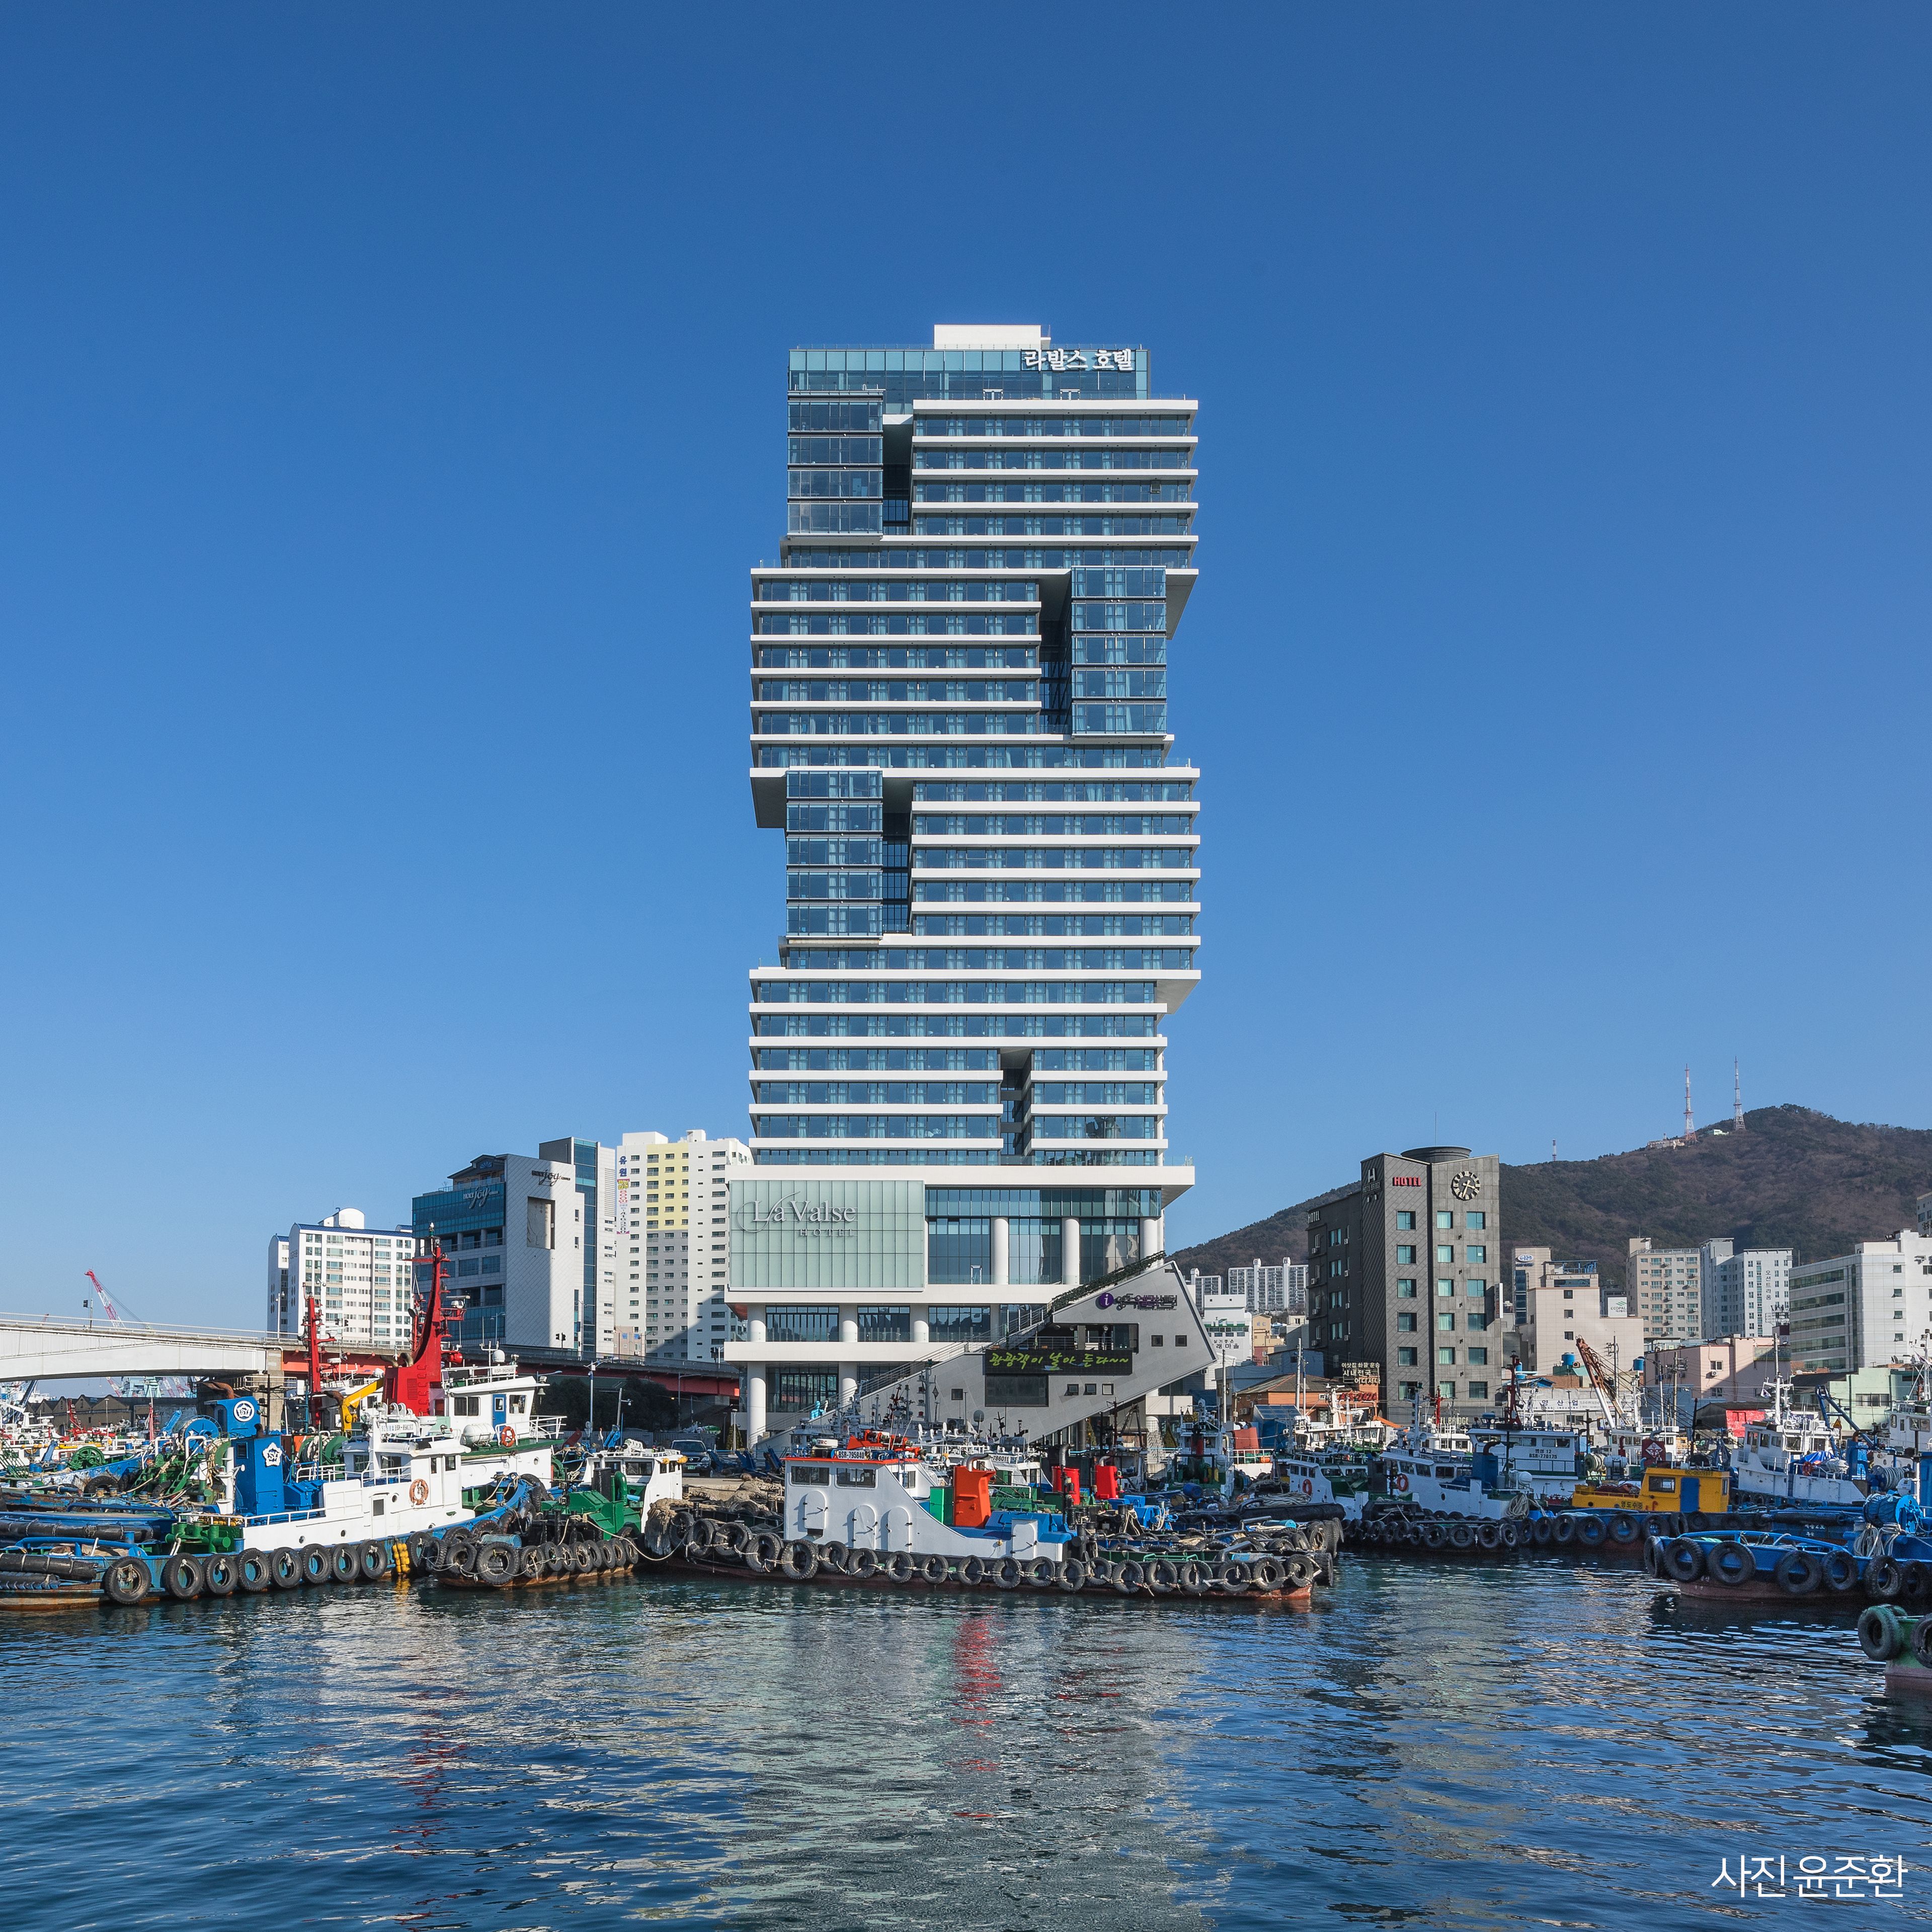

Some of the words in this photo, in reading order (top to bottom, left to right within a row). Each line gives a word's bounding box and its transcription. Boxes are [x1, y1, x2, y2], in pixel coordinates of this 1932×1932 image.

[1024, 348, 1088, 371] 라발스
[1092, 348, 1133, 371] 호텔
[1394, 1176, 1422, 1186] HOTEL
[1308, 1211, 1320, 1223] HOTEL
[799, 1228, 855, 1237] HOTEL
[989, 1352, 1042, 1370] 관광객이
[838, 1451, 864, 1459] BSR-795840
